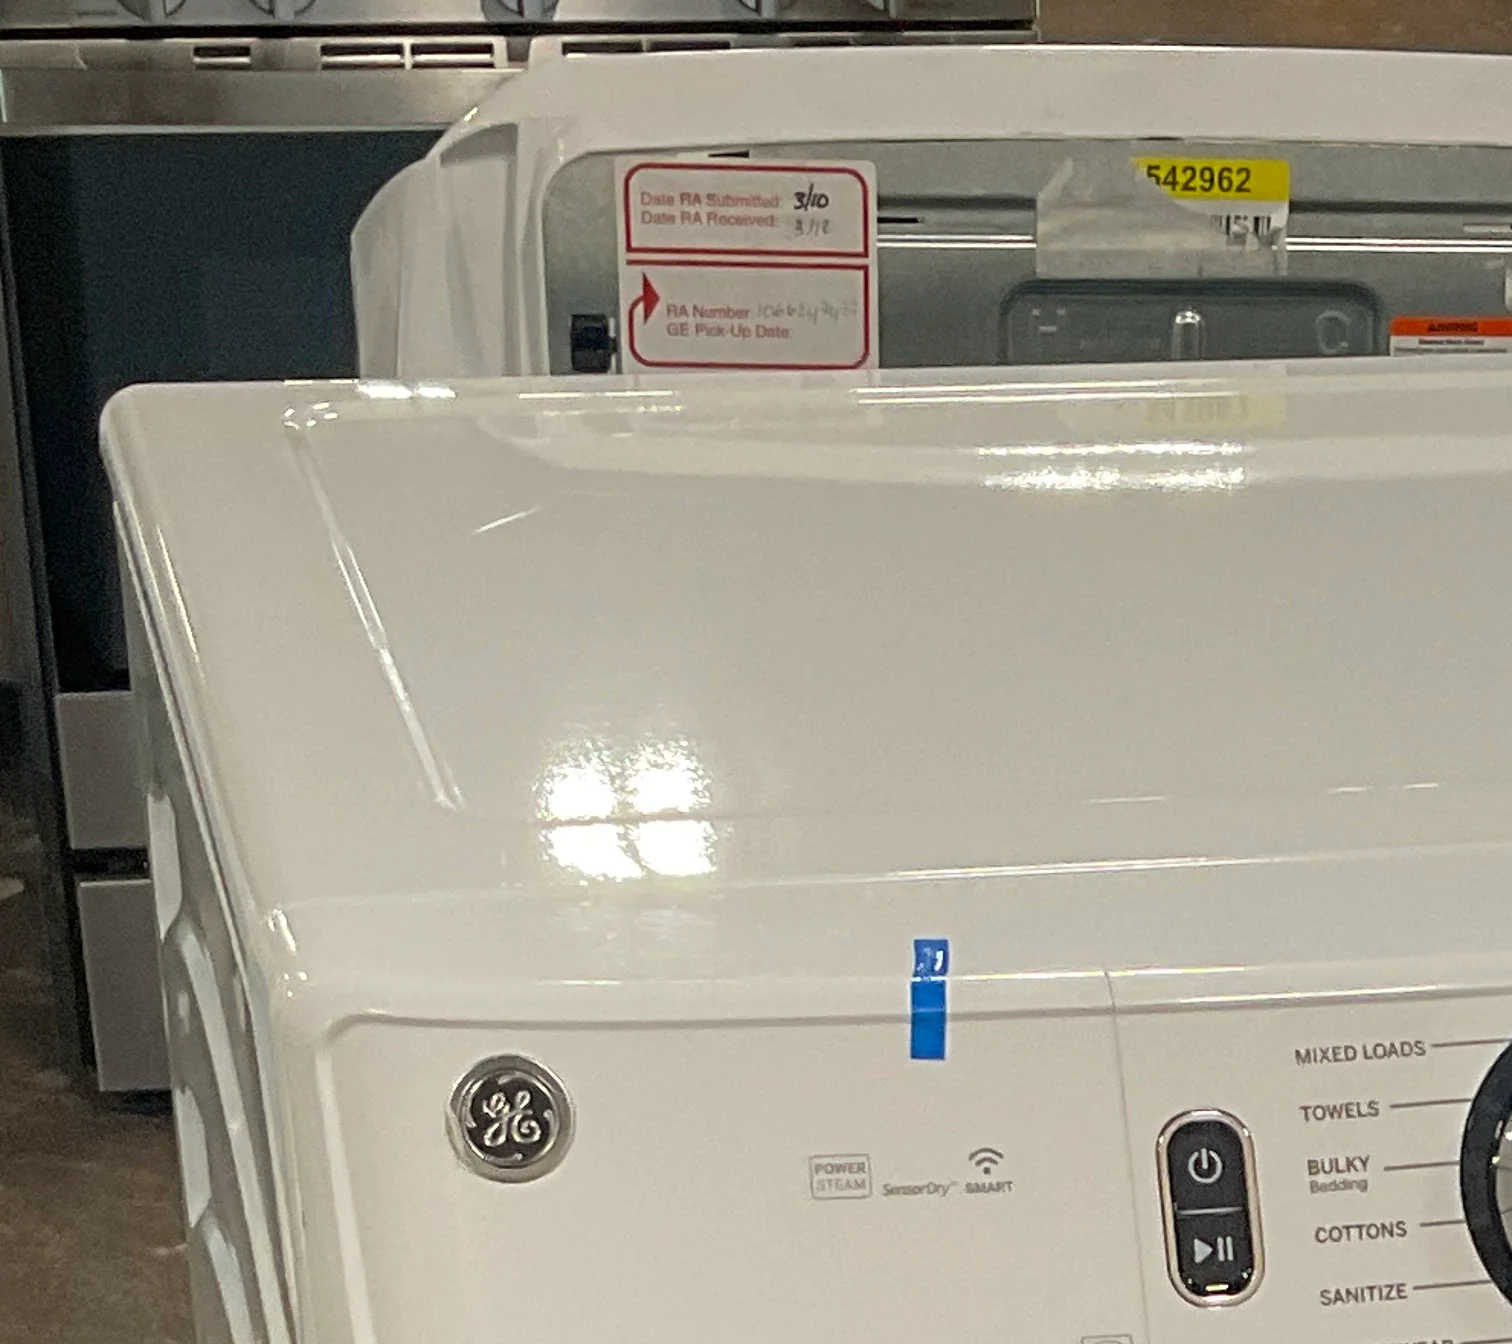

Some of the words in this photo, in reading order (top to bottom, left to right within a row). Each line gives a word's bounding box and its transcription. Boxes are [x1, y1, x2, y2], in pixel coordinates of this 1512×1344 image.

[1147, 165, 1251, 192] 542962
[640, 191, 675, 206] Date
[680, 192, 703, 207] RA
[793, 183, 829, 211] 3/10
[641, 211, 676, 226] Date
[681, 212, 703, 226] RA
[666, 303, 690, 318] RA
[666, 323, 690, 338] GE
[1294, 1042, 1357, 1066] MIXED
[1362, 1039, 1426, 1060] LOADS
[1299, 1100, 1380, 1122] TOWELS
[814, 1162, 866, 1175] POWER
[1307, 1155, 1371, 1176] BULKY
[815, 1178, 867, 1192] STEAM
[964, 1180, 1013, 1194] SMART
[1309, 1176, 1369, 1195] Bedding
[1315, 1220, 1408, 1243] COTTONS
[1319, 1282, 1408, 1306] SANITIZE
